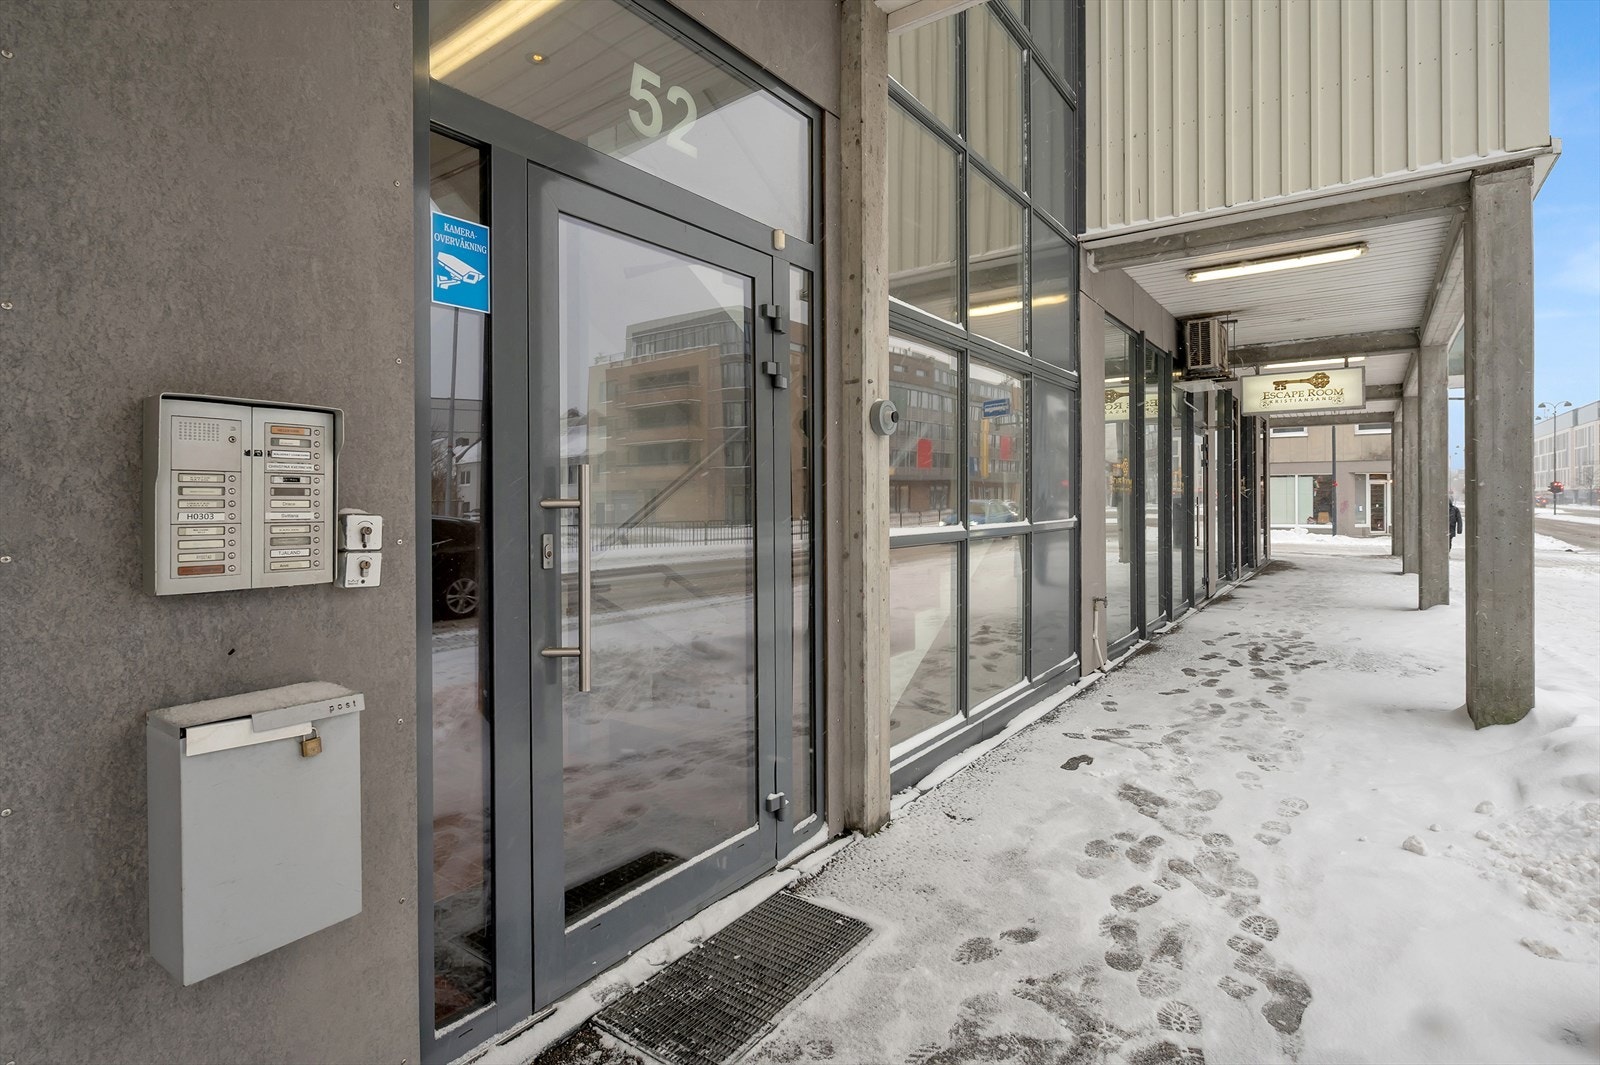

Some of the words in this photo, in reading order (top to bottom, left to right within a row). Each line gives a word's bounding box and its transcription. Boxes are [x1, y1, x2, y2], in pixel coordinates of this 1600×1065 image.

[628, 62, 698, 159] 52
[444, 222, 477, 239] KAMERA-
[434, 232, 487, 255] OVERVÅKNING
[1262, 390, 1305, 400] ESCAPE
[1308, 388, 1344, 397] ROOM
[329, 701, 358, 713] post
